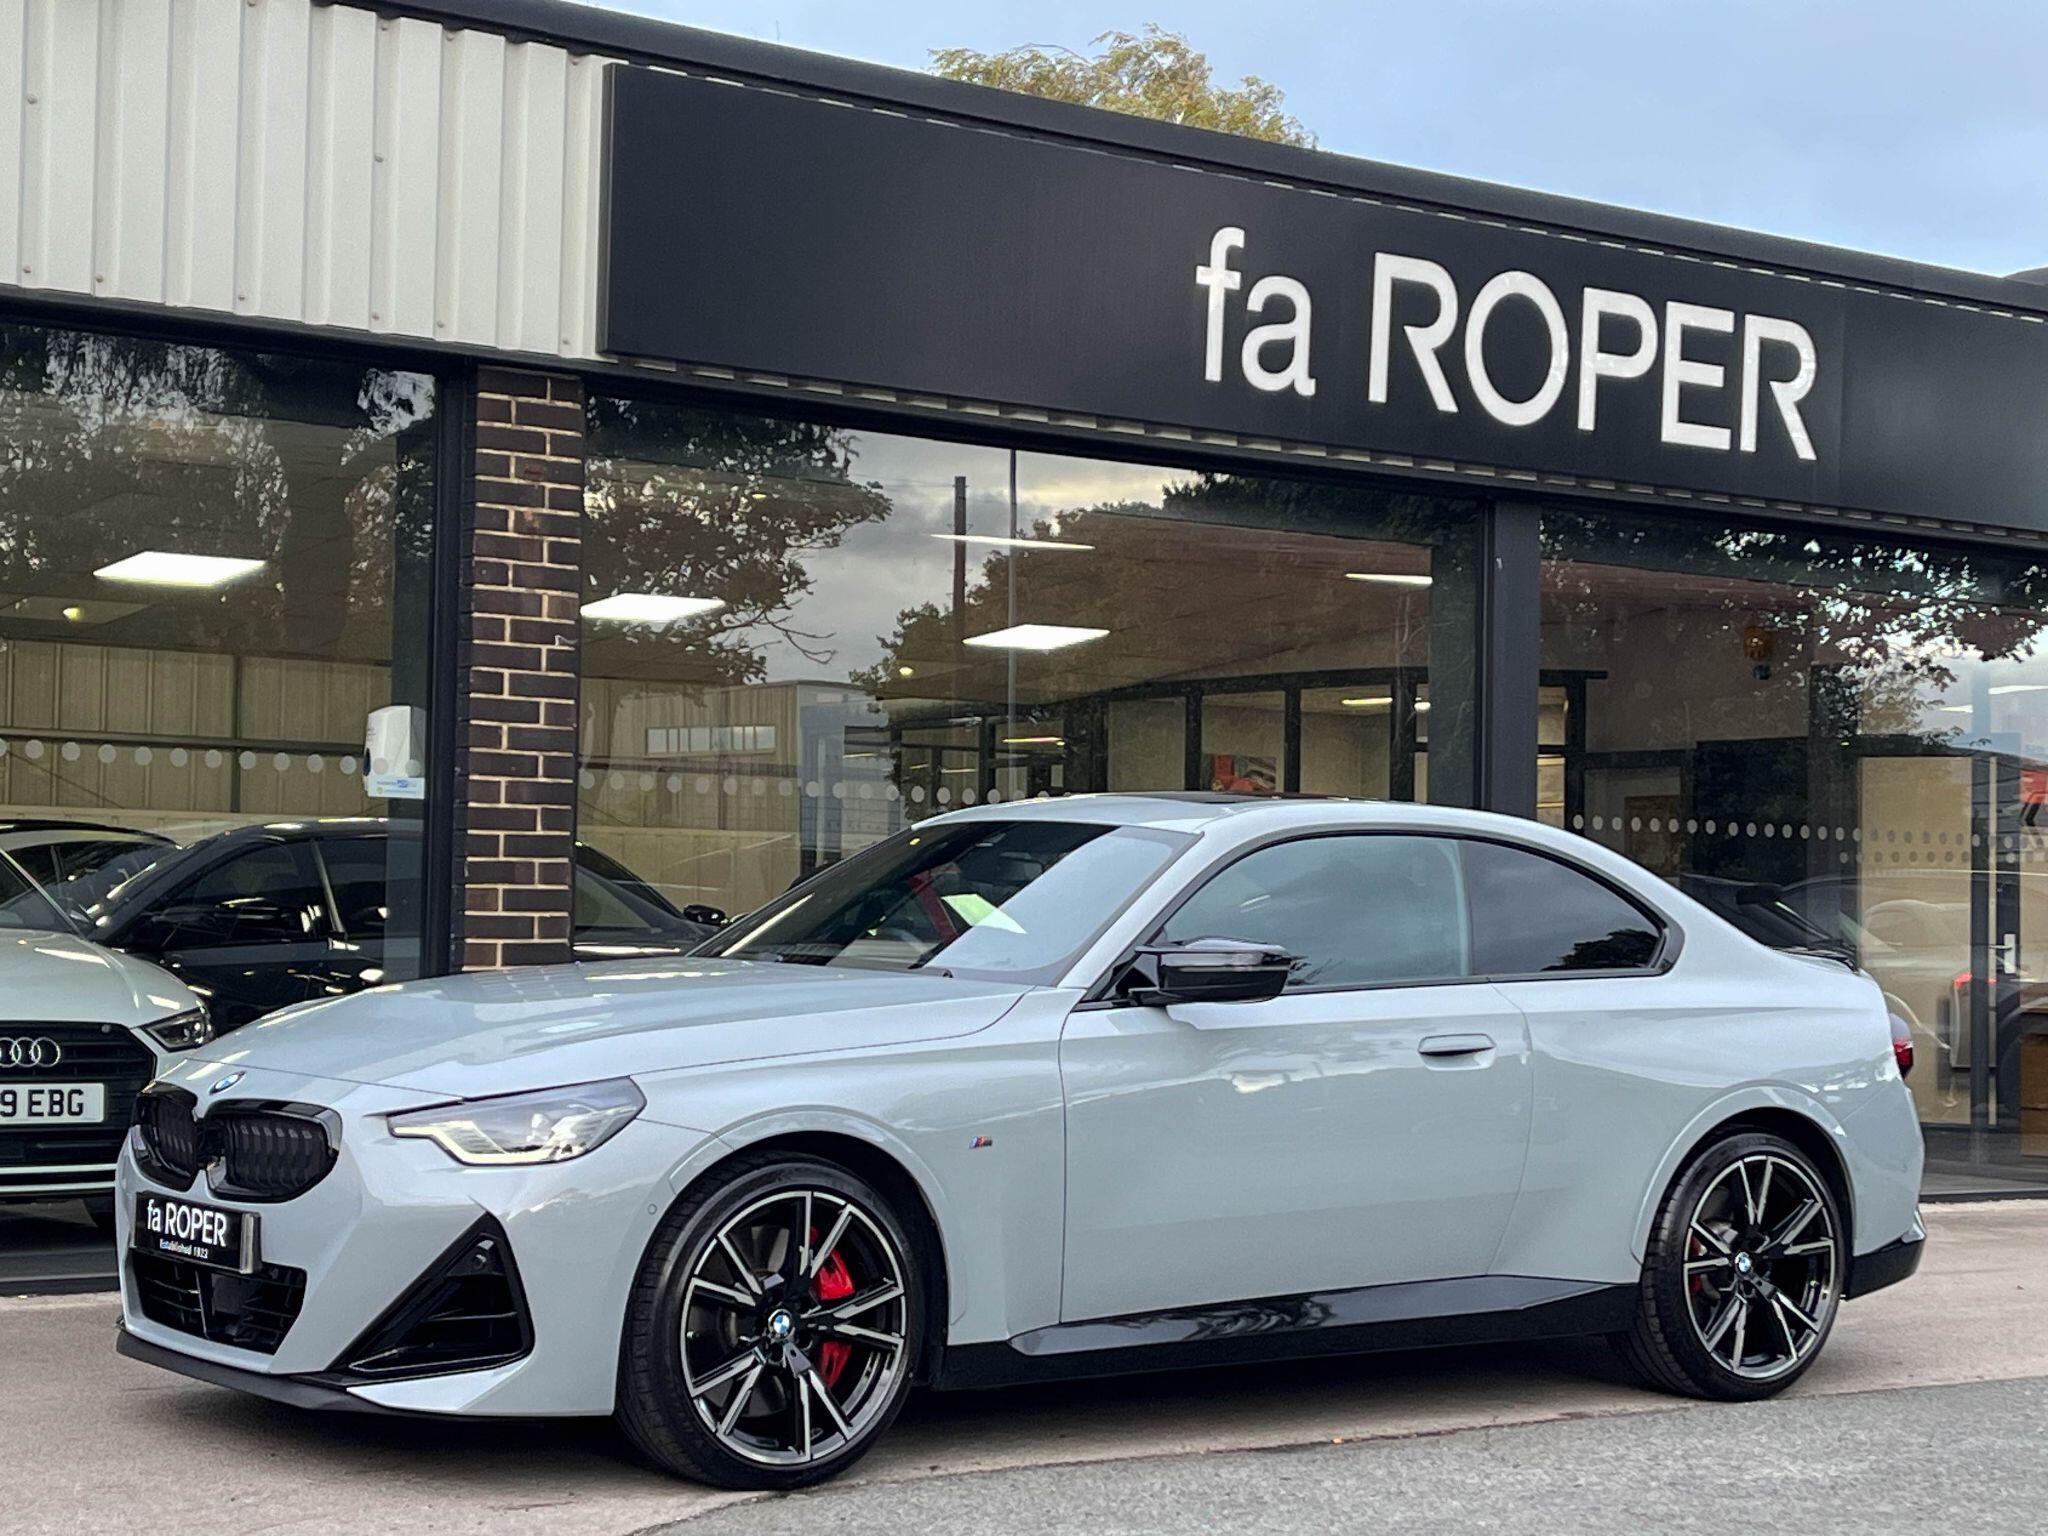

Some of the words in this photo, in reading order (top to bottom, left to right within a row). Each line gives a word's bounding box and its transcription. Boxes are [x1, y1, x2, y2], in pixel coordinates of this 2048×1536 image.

[1195, 226, 1316, 397] fa
[1367, 251, 1817, 460] ROPER
[28, 1089, 84, 1117] EBG
[147, 1199, 161, 1232] fa
[164, 1202, 227, 1247] ROPER
